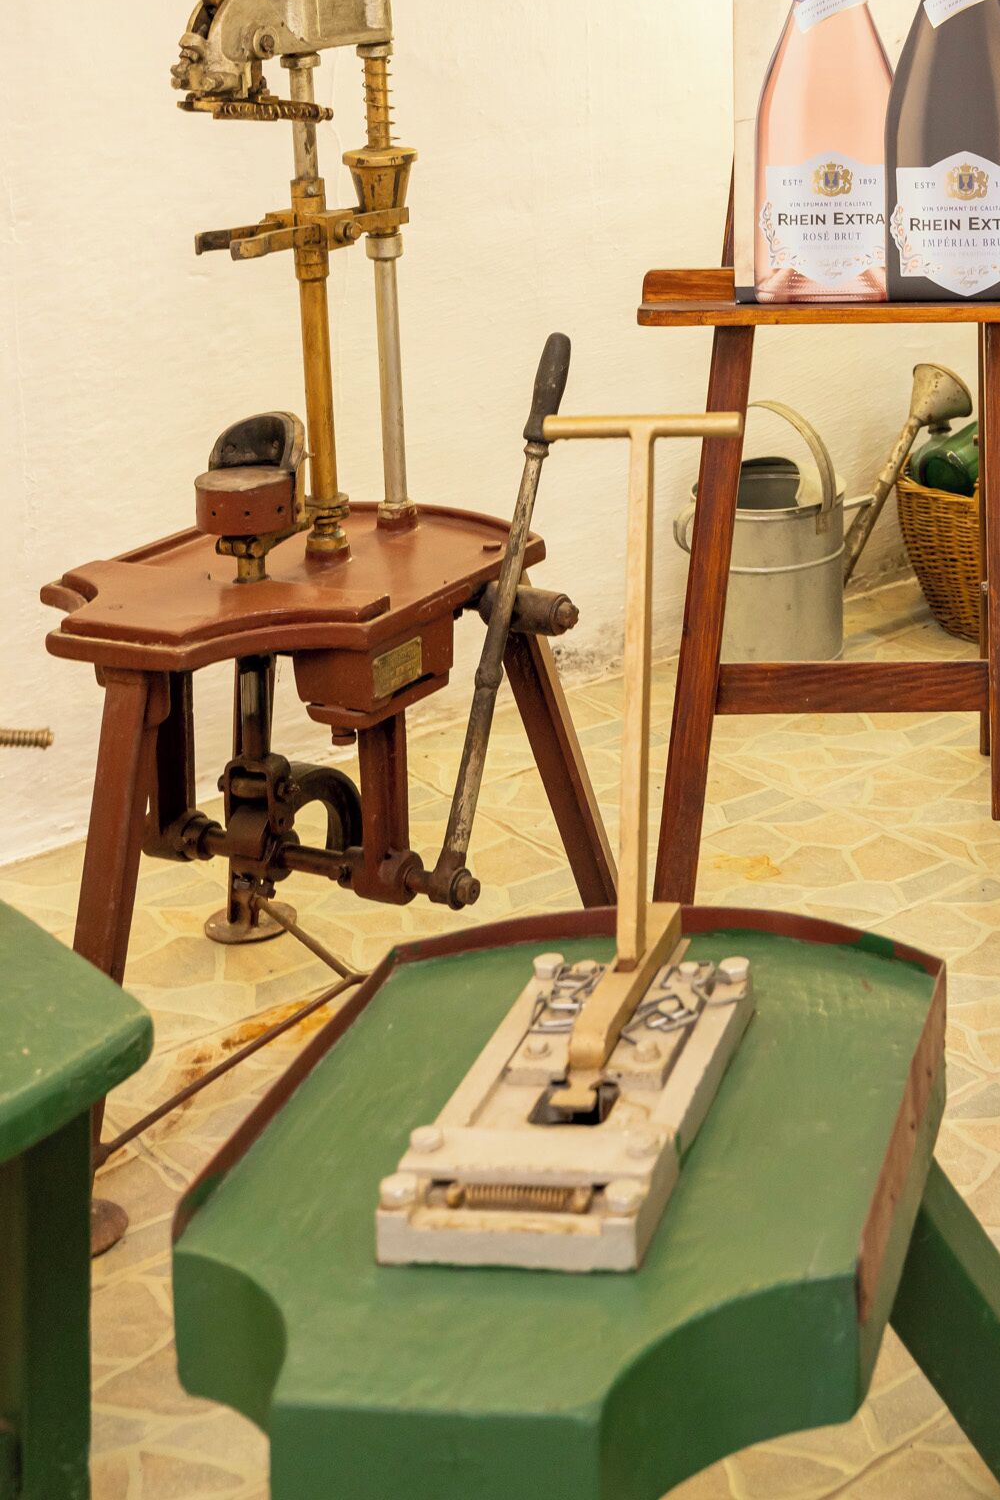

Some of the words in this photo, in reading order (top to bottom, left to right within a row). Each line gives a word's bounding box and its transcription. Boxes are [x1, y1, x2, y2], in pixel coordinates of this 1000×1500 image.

[778, 213, 826, 226] RHEIN
[834, 212, 885, 225] EXTRA
[910, 218, 960, 231] RHEIN
[802, 231, 830, 241] ROSÉ
[922, 236, 977, 248] IMPÉRIAL
